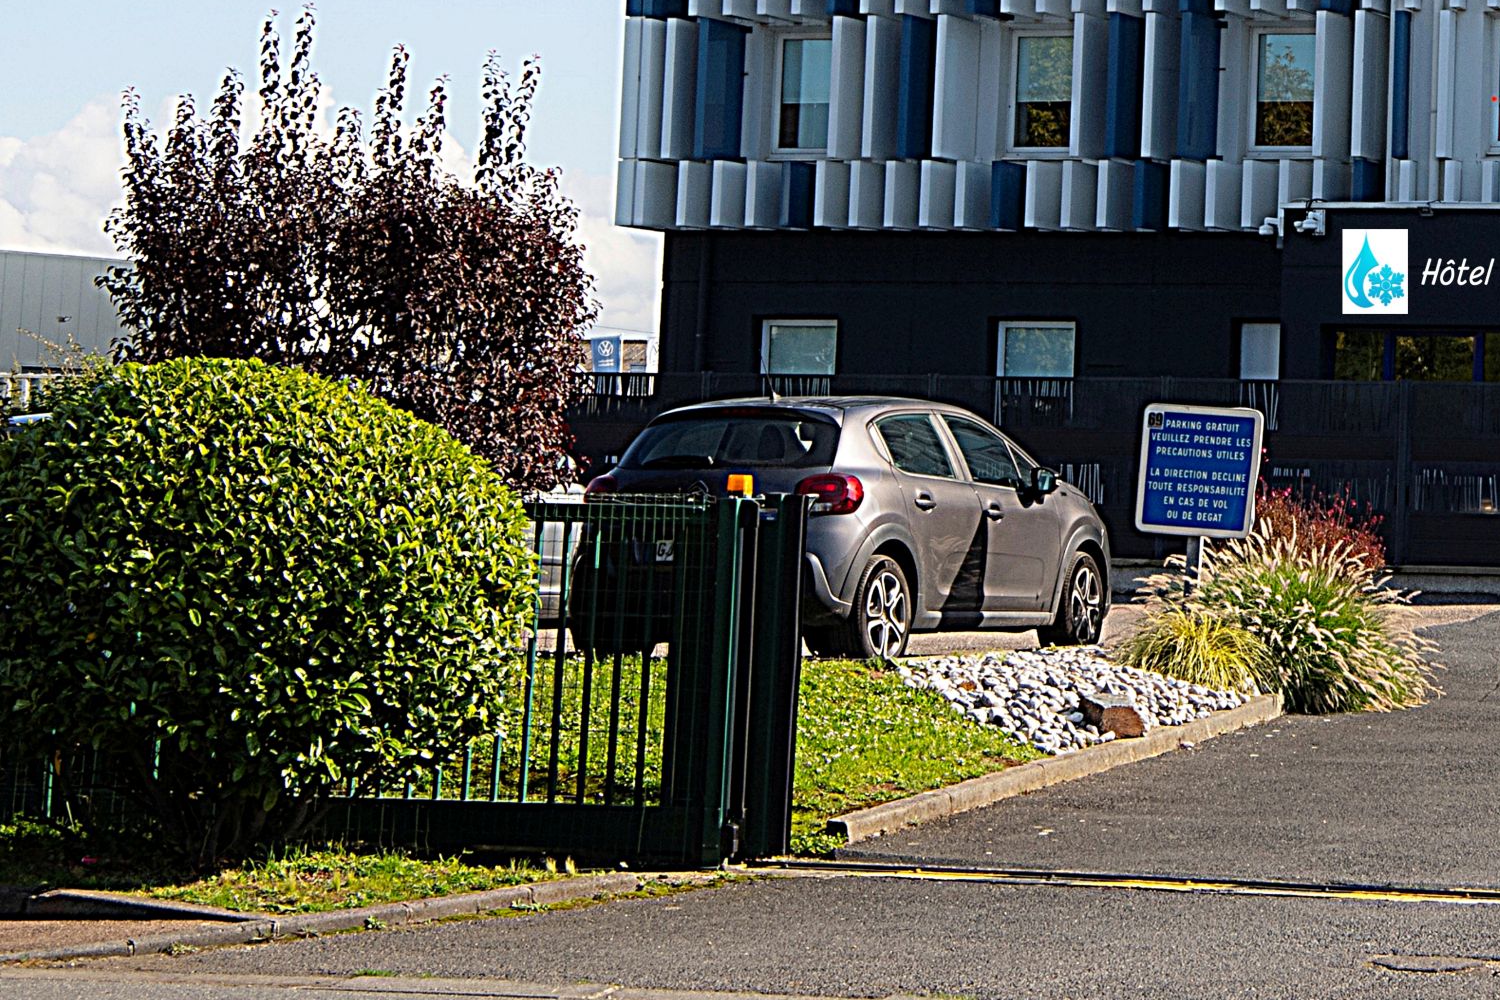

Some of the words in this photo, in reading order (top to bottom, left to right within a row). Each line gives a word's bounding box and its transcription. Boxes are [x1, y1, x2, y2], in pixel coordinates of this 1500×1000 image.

[1420, 257, 1495, 286] Hôtel
[1165, 419, 1202, 431] PARKING
[1205, 422, 1240, 433] GRATUIT
[1151, 432, 1190, 443] VEUILLEZ
[1193, 435, 1232, 446] PRENDRE
[1236, 438, 1251, 448] LES
[1155, 446, 1213, 458] PRECAUTIONS
[1216, 450, 1245, 461] UTILES
[1150, 467, 1160, 476] LA
[1164, 468, 1208, 480] DIRECTION
[1211, 472, 1246, 483] DECLINE
[1148, 481, 1173, 491] TOUTE
[1176, 483, 1246, 497] RESPONSABILITE
[1163, 496, 1175, 505] EN
[1178, 497, 1195, 507] CAS
[1198, 498, 1209, 508] DE
[1212, 499, 1228, 510] VOL
[1166, 510, 1178, 519] OU
[1182, 511, 1193, 520] DE
[1196, 511, 1223, 522] DEGAT
